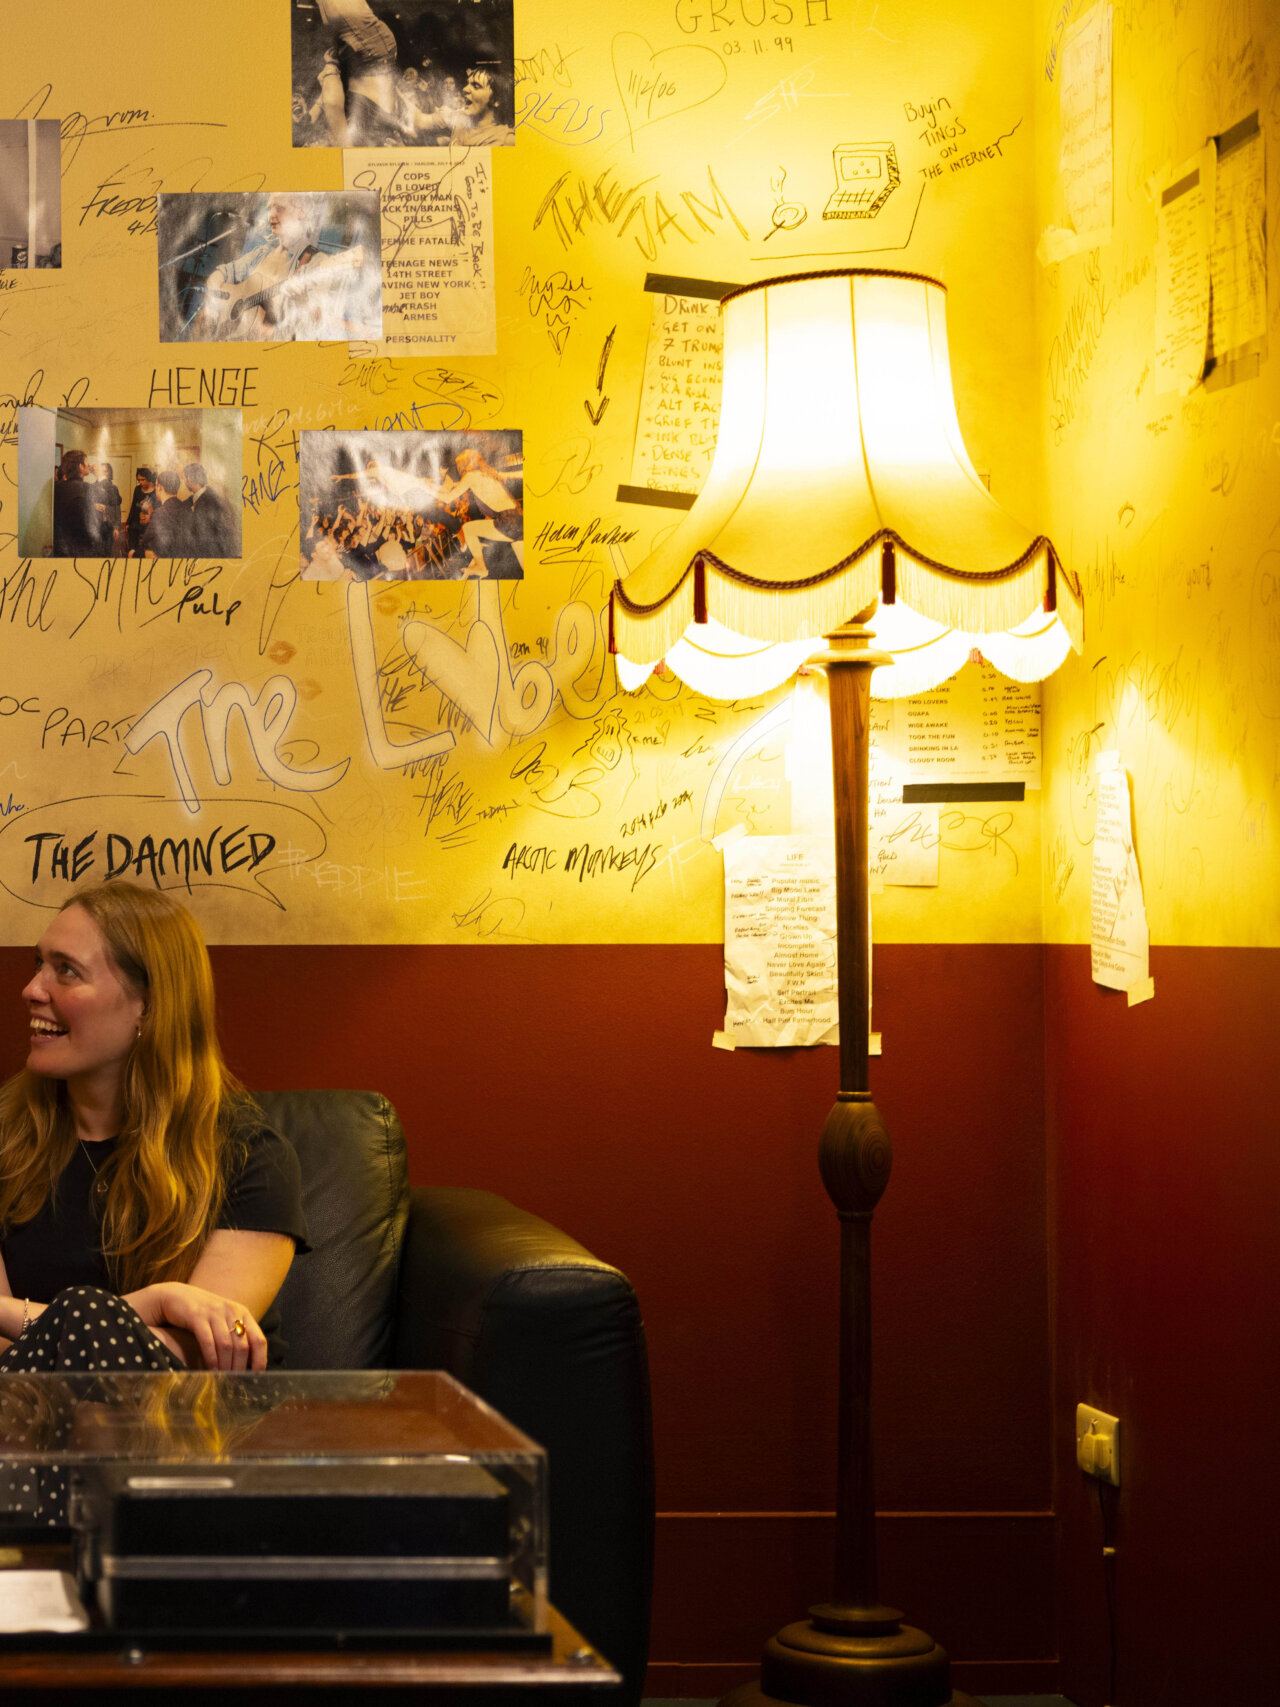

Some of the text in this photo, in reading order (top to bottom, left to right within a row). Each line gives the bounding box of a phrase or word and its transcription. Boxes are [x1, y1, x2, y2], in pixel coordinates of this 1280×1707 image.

[919, 117, 966, 146] TINGS
[919, 143, 1003, 178] THE INTERNET
[940, 143, 958, 158] ON
[399, 292, 416, 300] JET
[386, 335, 456, 343] PERSONALITY
[150, 367, 259, 407] HENGE
[24, 831, 99, 884] THE
[106, 825, 276, 895] DAMNED
